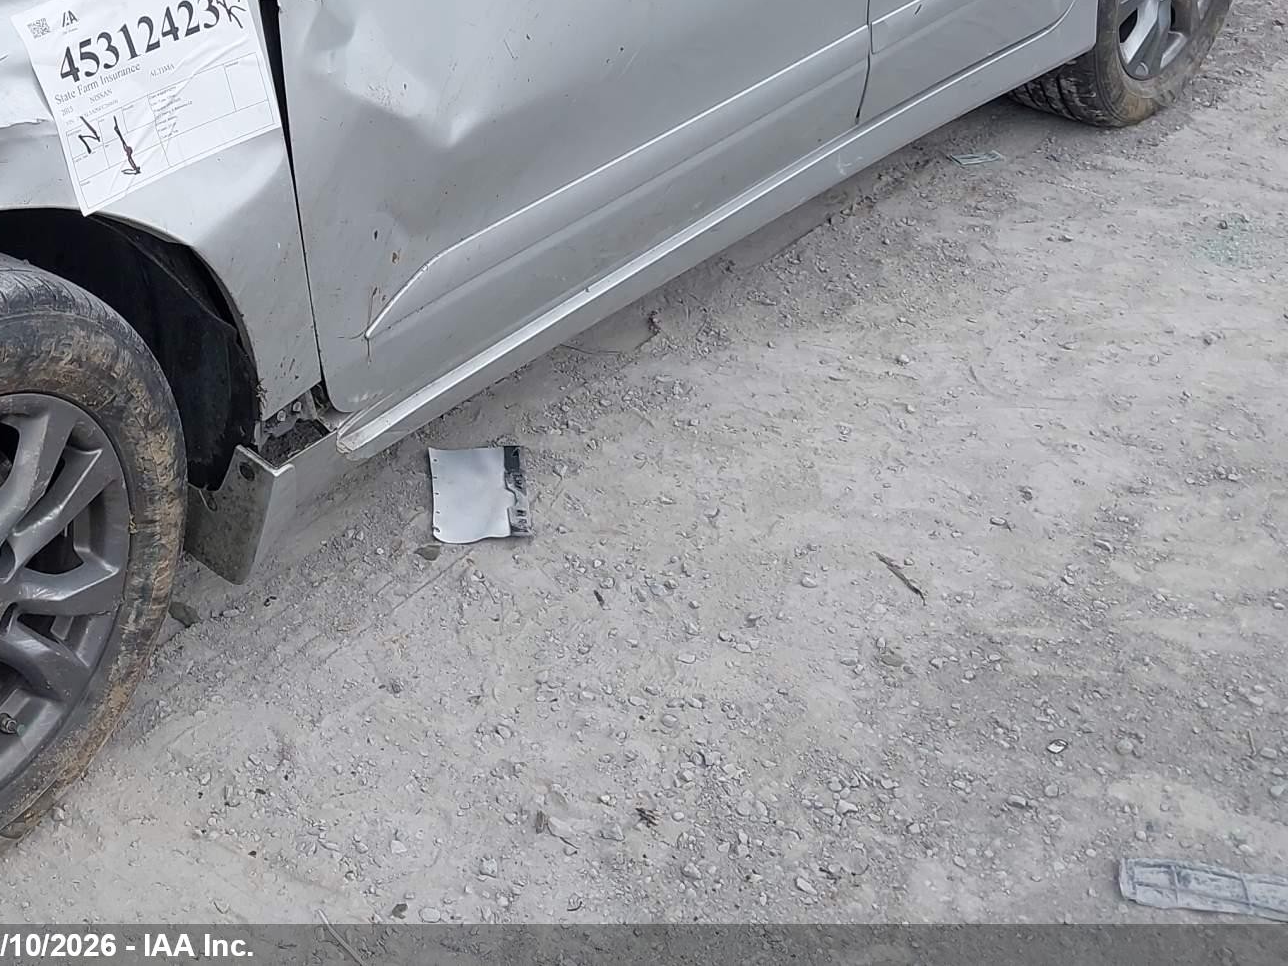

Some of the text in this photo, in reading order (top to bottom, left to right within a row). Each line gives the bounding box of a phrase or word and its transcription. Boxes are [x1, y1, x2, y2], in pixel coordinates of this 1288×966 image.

[54, 63, 141, 106] State Farm Insurance
[89, 89, 113, 104] NISSAN
[150, 64, 175, 77] ALTIMA
